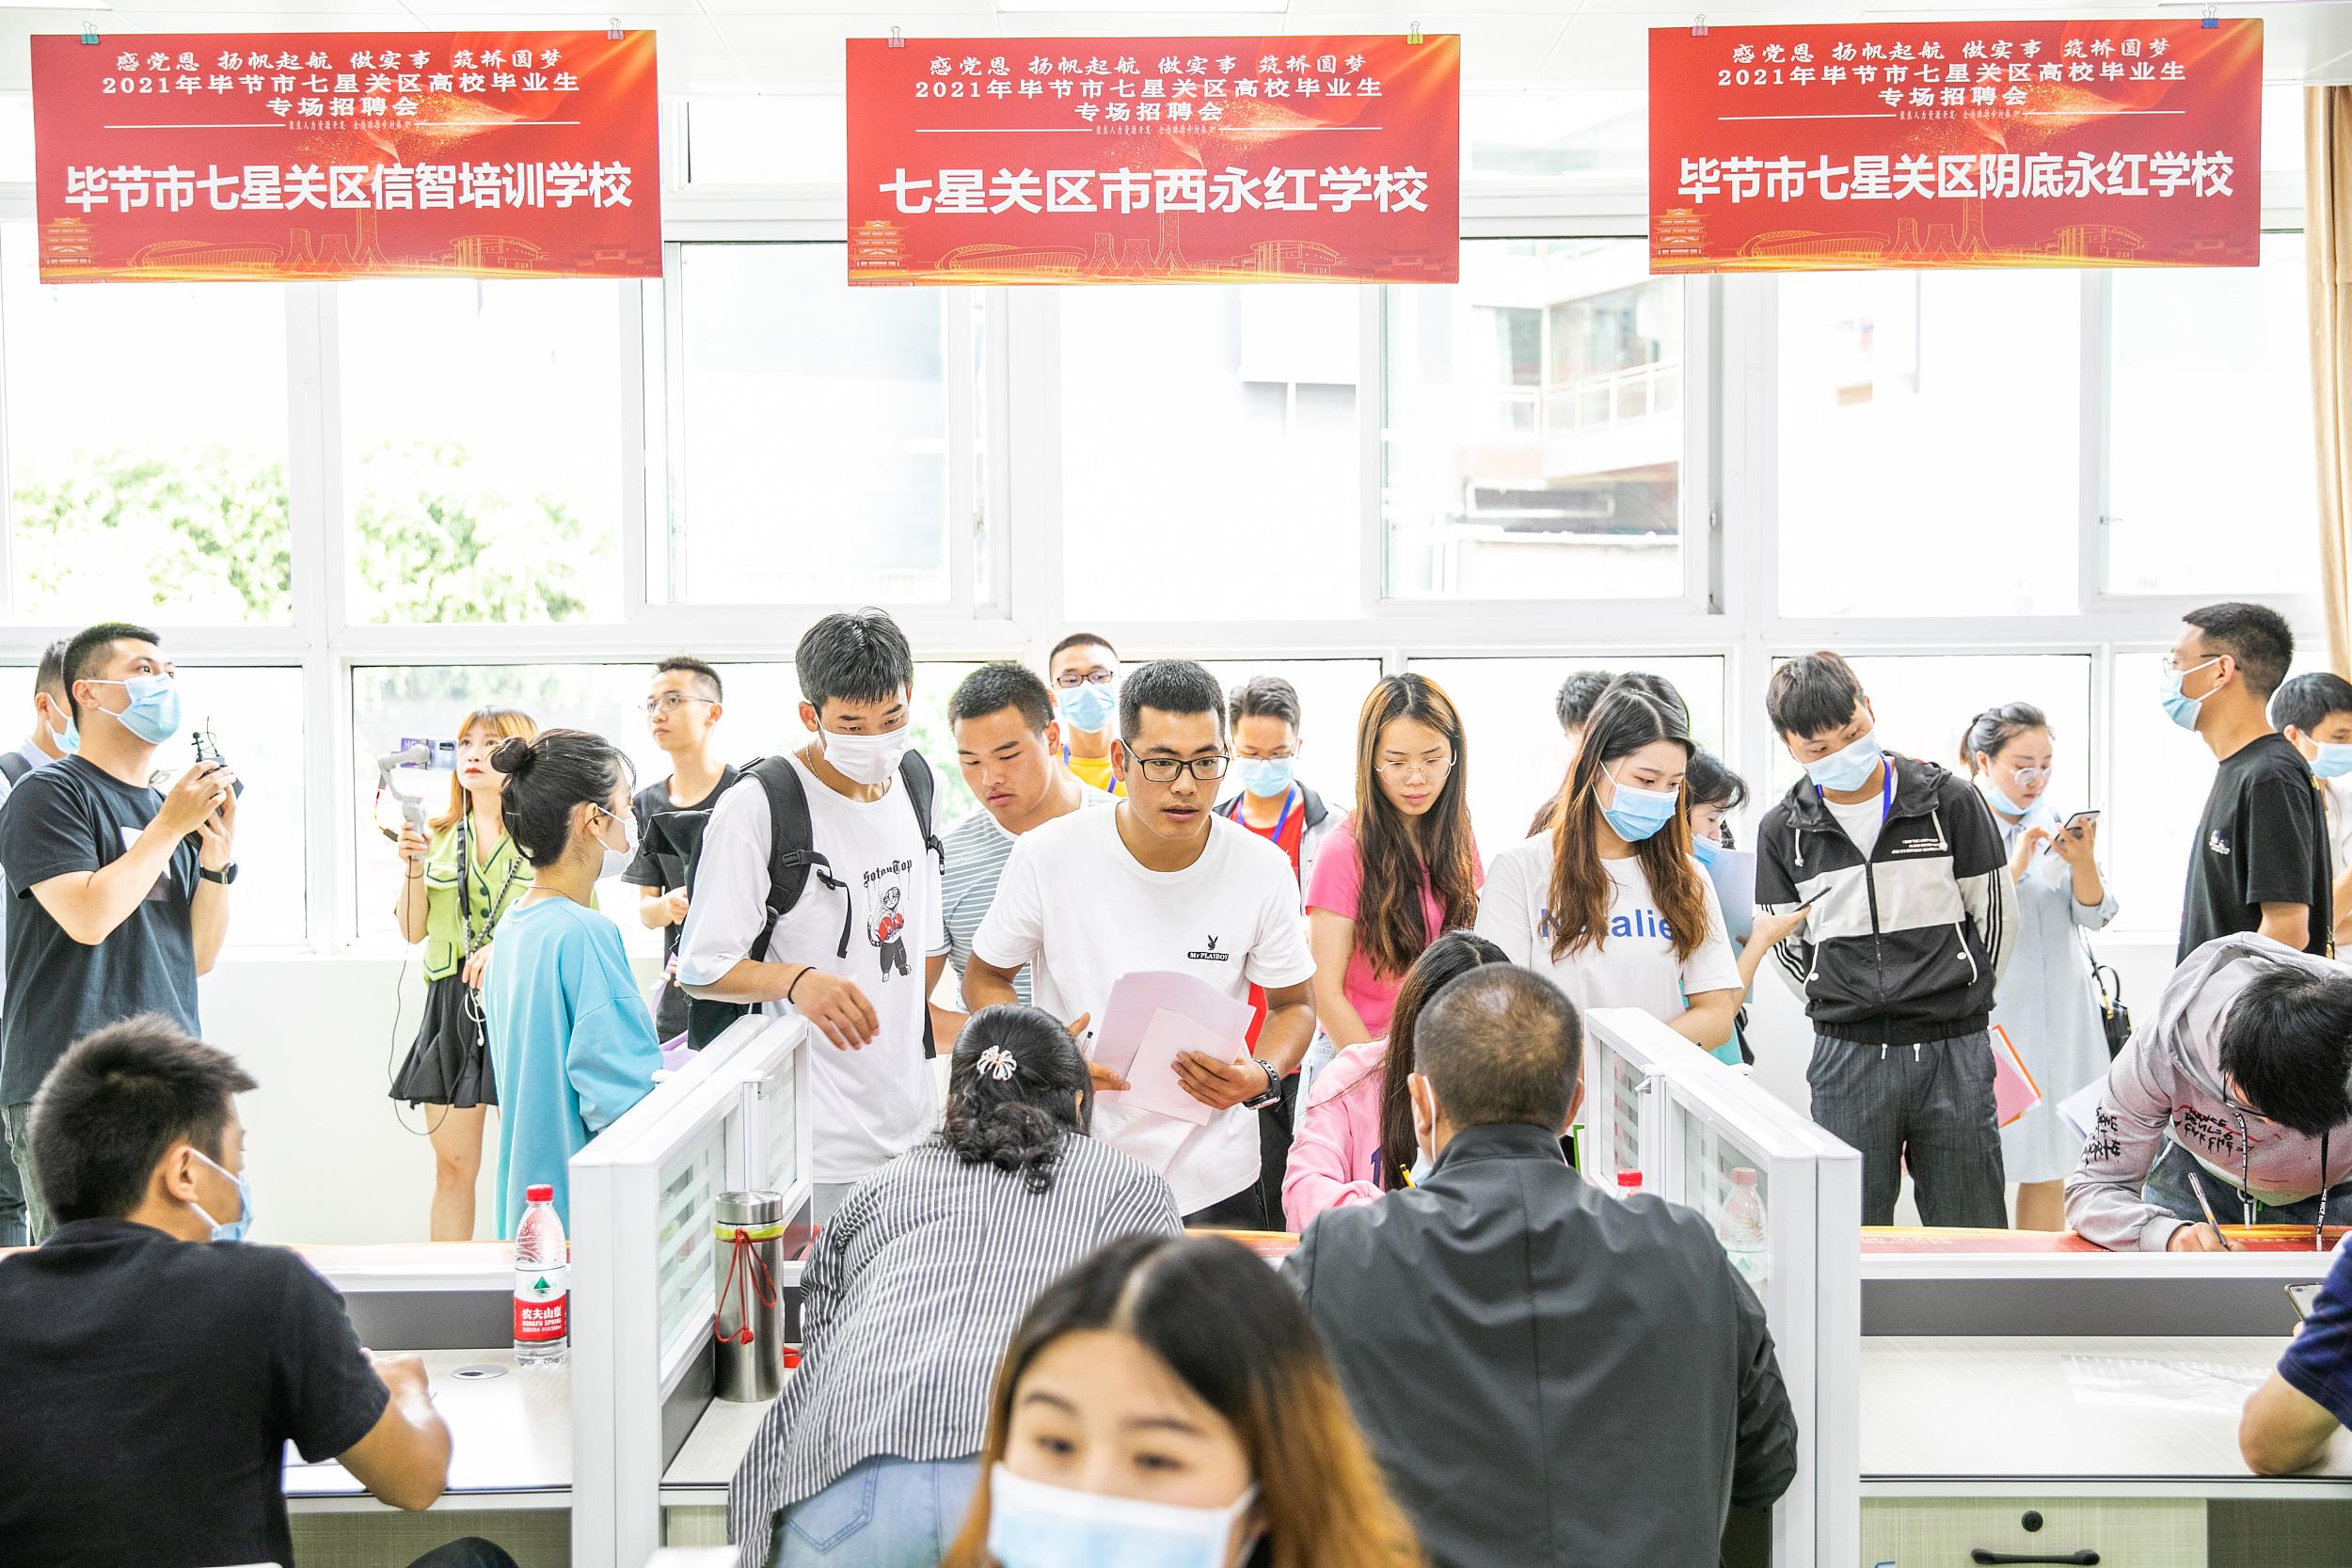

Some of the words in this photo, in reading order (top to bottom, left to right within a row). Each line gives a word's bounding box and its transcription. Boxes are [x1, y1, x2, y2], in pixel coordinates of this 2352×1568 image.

[117, 51, 199, 71] 感党恩
[218, 50, 333, 71] 扬帆起航
[350, 49, 431, 70] 做实事
[453, 48, 563, 70] 筑桥圆梦
[1732, 43, 1815, 64] 感党恩
[1831, 40, 1946, 62] 扬帆起航
[1963, 39, 2042, 60] 做实事
[2063, 37, 2170, 59] 筑桥圆梦
[930, 55, 1010, 76] 感党恩
[1027, 55, 1141, 75] 扬帆起航
[1157, 54, 1237, 75] 做实事
[1259, 53, 1367, 74] 筑桥圆梦
[1718, 60, 2186, 87] 2021年毕节市七星关区高校毕业生
[103, 72, 580, 95] 2021年毕节市七星关区高校毕业生
[915, 77, 1383, 100] 2021年毕节市七星关区高校毕业生
[265, 96, 420, 118] 专场招聘会
[1877, 86, 2029, 108] 专场招聘会
[1073, 101, 1225, 122] 专场招聘会
[65, 160, 633, 214] 毕节市七星关区信智培训学校
[1677, 150, 2234, 204] 毕节市七星关区阴底永红学校
[879, 166, 1429, 214] 七星关区市西永红学校
[1540, 909, 1673, 941] Nalie
[521, 1306, 562, 1320] 农夫山泉
